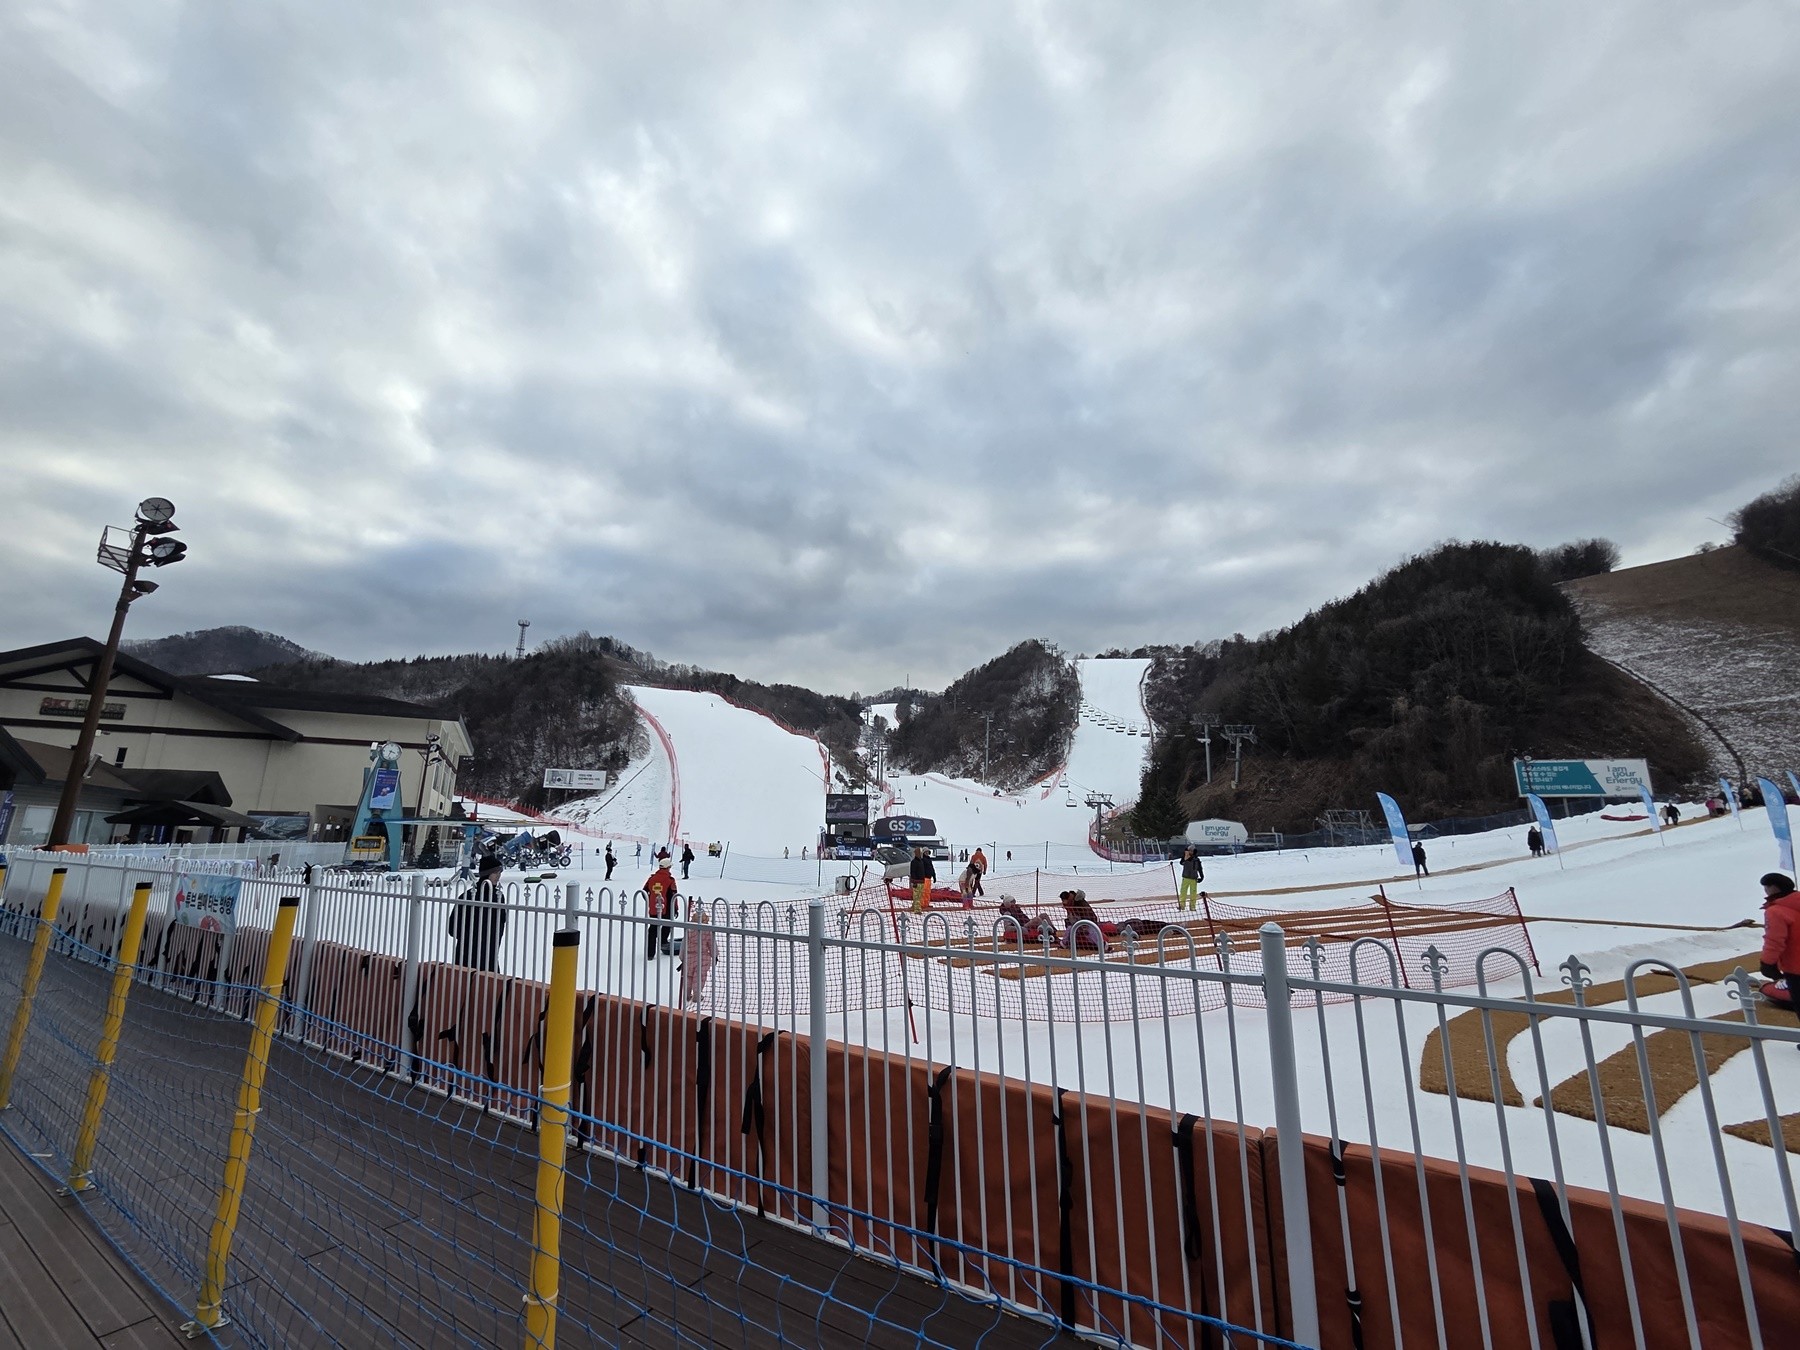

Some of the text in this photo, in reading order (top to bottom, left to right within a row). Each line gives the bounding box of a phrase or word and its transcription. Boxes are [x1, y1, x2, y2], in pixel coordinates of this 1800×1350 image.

[41, 697, 72, 710] SKI
[1606, 776, 1643, 785] Energy
[1612, 771, 1636, 779] your
[889, 819, 922, 832] GS25
[185, 891, 197, 909] 튜브
[208, 894, 219, 914] 타는
[219, 896, 234, 915] 방향
